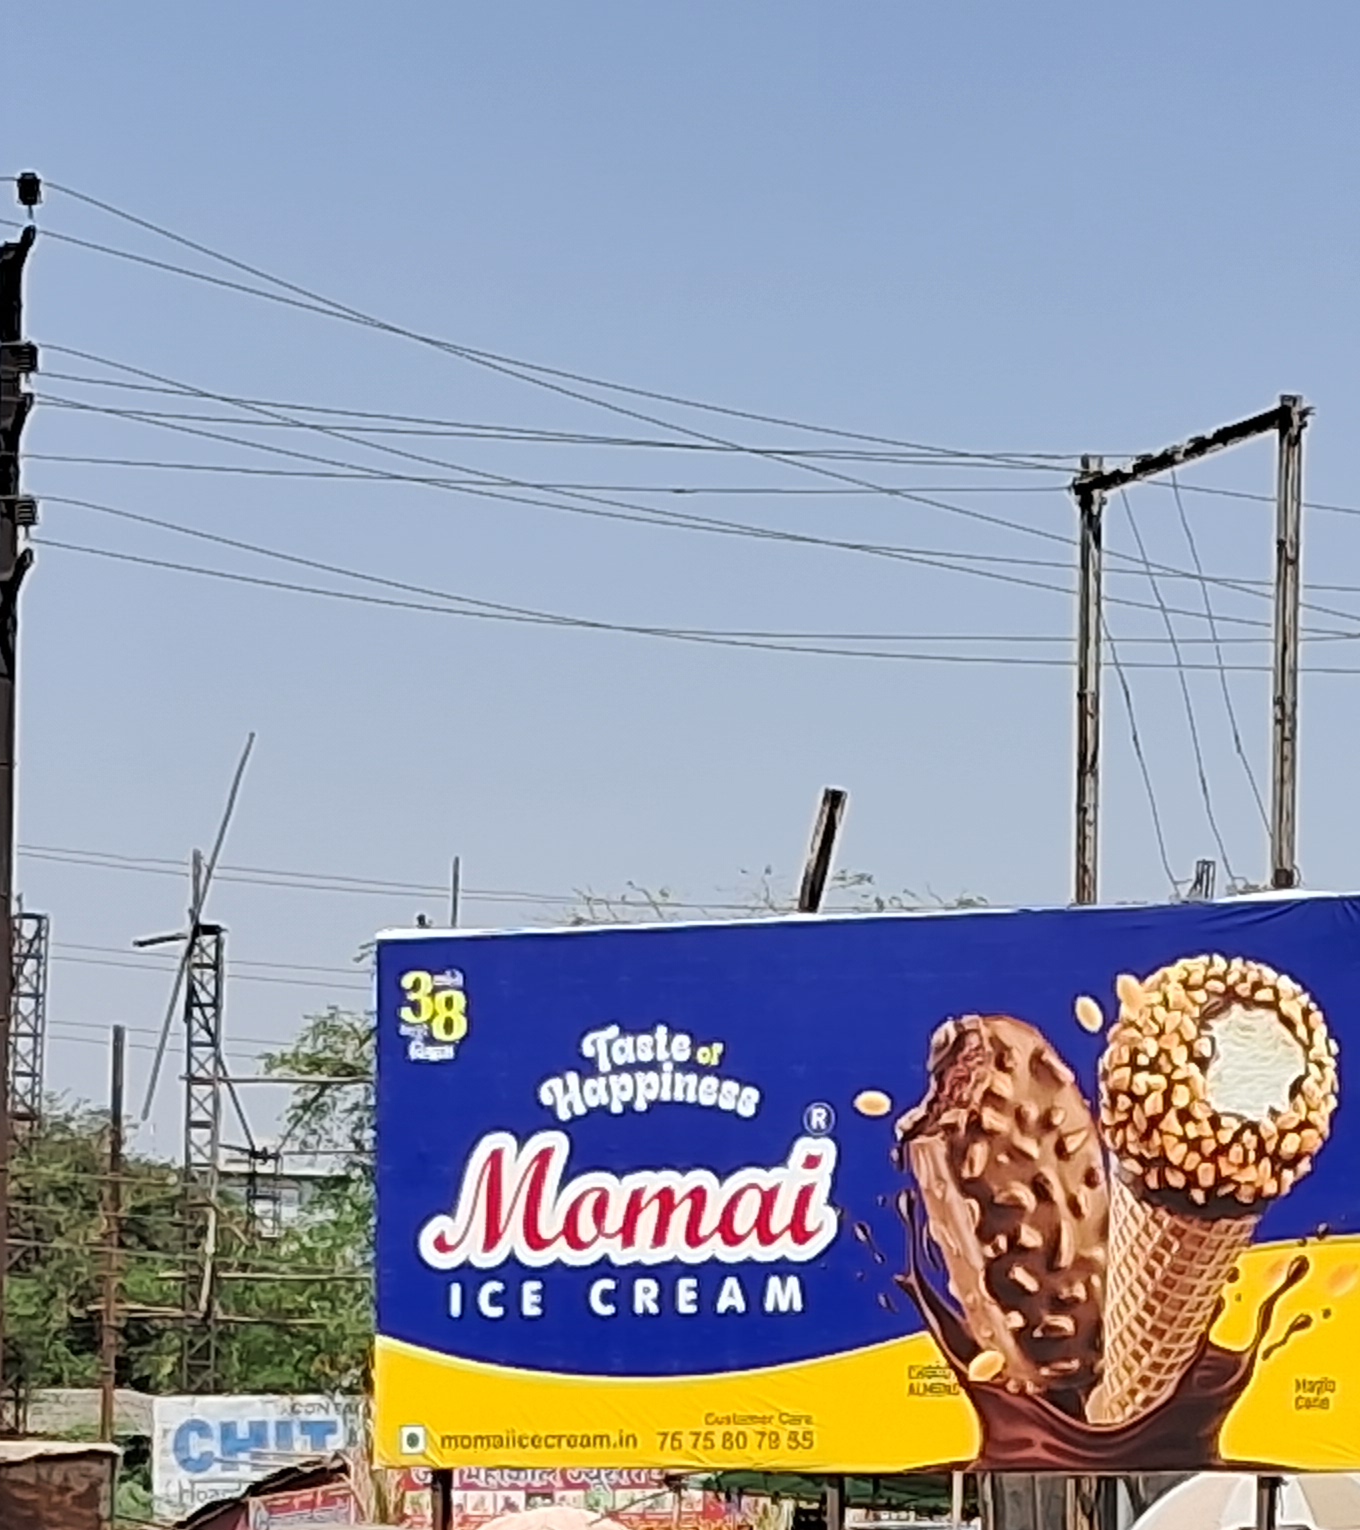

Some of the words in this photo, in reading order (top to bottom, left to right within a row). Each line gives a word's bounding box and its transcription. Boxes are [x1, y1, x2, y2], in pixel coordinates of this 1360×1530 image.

[400, 969, 468, 1043] 38
[581, 1024, 691, 1072] Taste
[540, 1061, 760, 1121] Happiness
[426, 1138, 830, 1260] Momai
[448, 1281, 544, 1319] ICE
[589, 1275, 804, 1317] CREAM
[173, 1418, 338, 1474] CHIT
